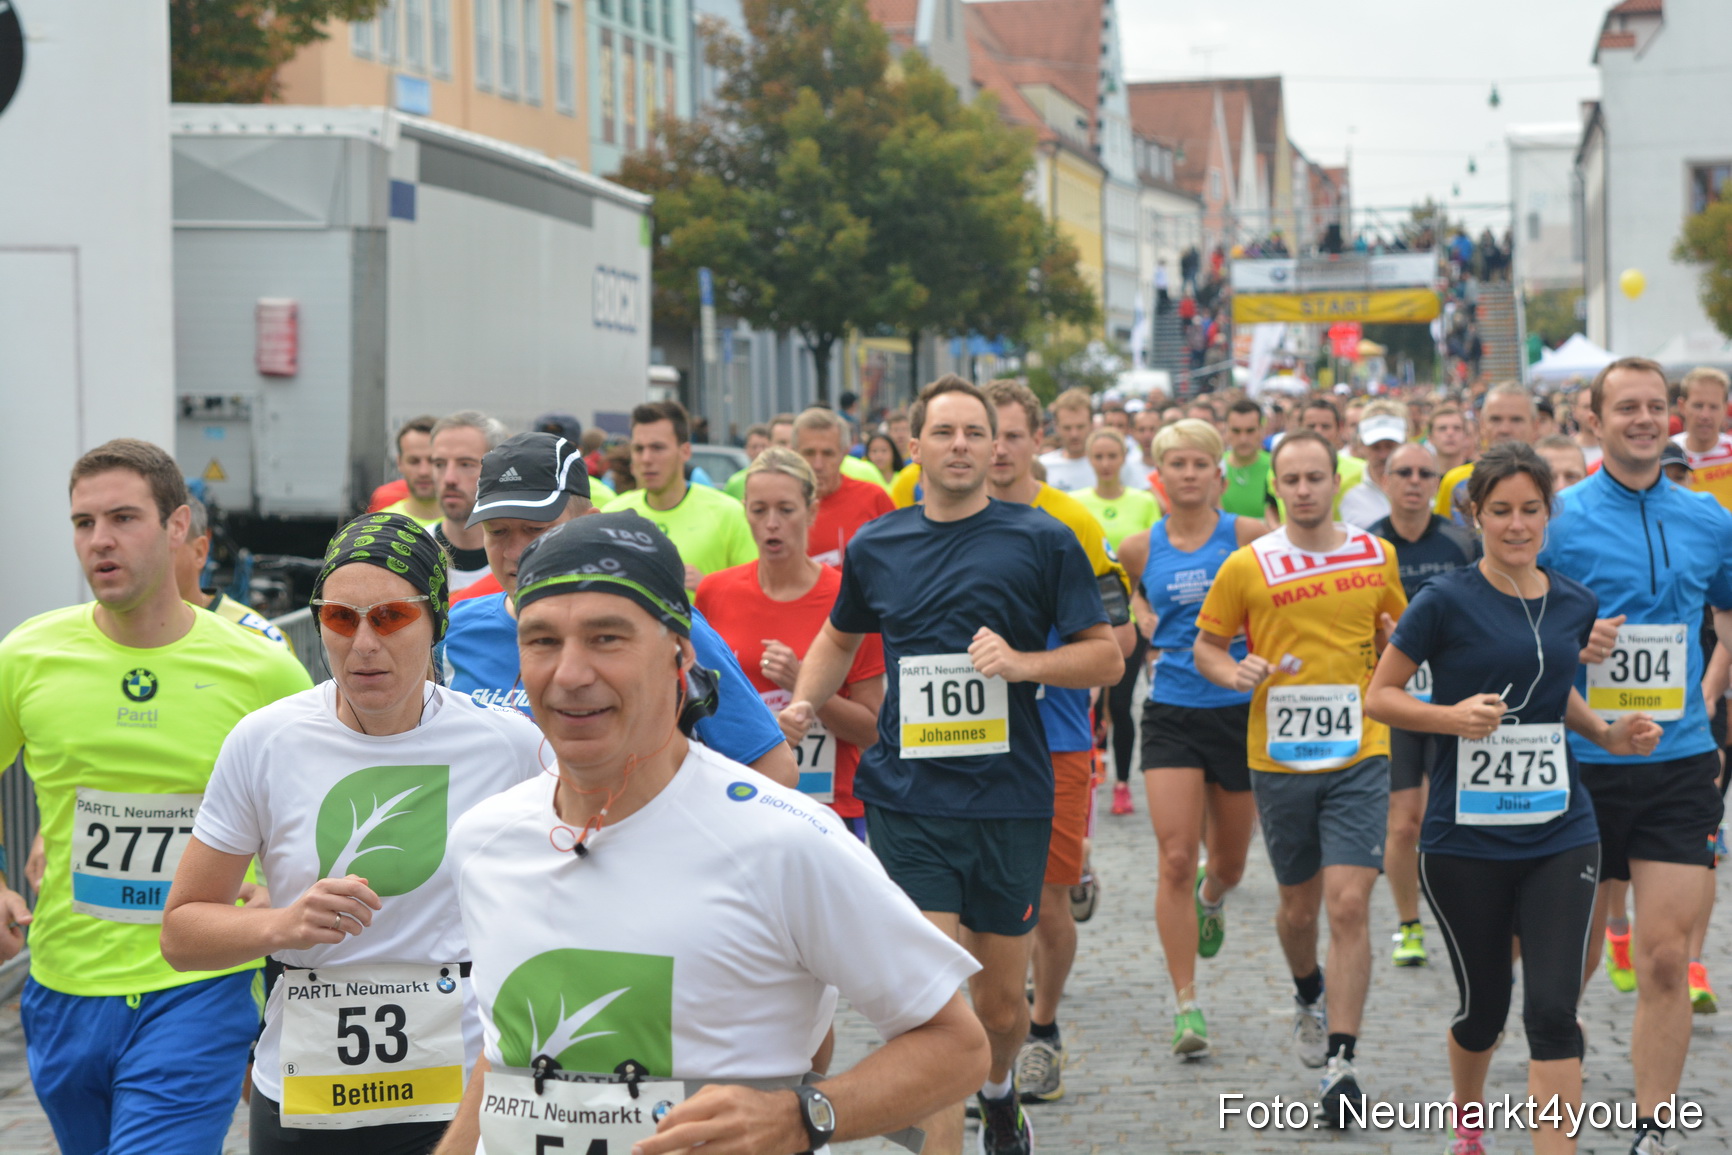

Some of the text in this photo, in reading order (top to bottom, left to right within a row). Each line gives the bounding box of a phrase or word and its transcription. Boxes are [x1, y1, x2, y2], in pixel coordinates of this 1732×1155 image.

[1301, 300, 1370, 315] START
[600, 528, 653, 544] TAO
[1271, 572, 1387, 608] MAX BÖGL
[902, 666, 932, 676] PARTL
[1610, 649, 1670, 683] 304
[920, 679, 985, 717] 160
[1619, 692, 1662, 707] Simon
[117, 706, 158, 722] Partl
[1278, 706, 1352, 736] 2794
[919, 728, 986, 743] Johannes
[1470, 750, 1557, 785] 2475
[77, 799, 194, 818] PARTL Neumarkt
[1495, 795, 1531, 811] Julia
[759, 794, 828, 834] Bionorica
[122, 886, 161, 905] Ralf
[288, 983, 342, 1000] PARTL
[346, 981, 430, 996] Neumarkt
[337, 1004, 408, 1066] 53
[333, 1080, 414, 1106] Bettina
[484, 1095, 539, 1119] PARTL
[545, 1102, 642, 1124] Neumarkt
